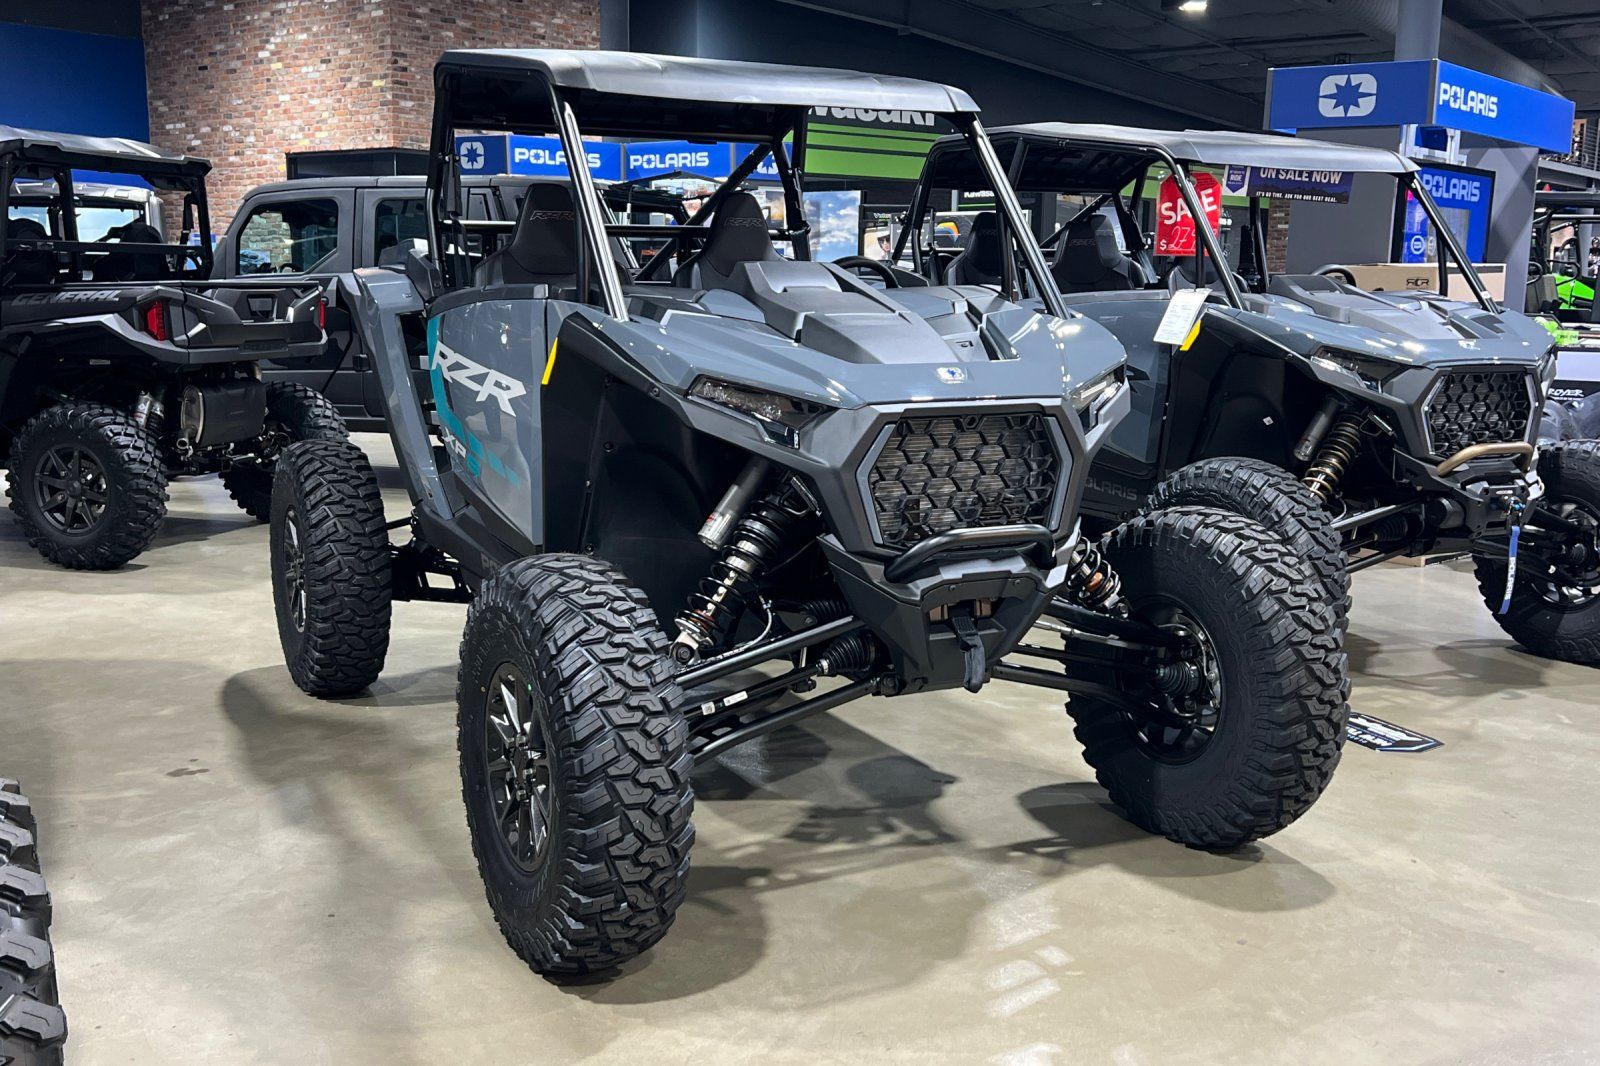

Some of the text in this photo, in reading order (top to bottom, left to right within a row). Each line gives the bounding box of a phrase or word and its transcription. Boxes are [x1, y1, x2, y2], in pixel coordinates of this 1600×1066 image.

[1439, 82, 1499, 118] POLARIS
[514, 147, 601, 168] POLAS
[629, 151, 710, 169] POLARIS
[1278, 169, 1310, 182] SALE
[1311, 171, 1342, 185] NOW
[1422, 173, 1481, 203] POLARIS
[1160, 188, 1218, 225] SAE
[10, 289, 122, 306] GENERAL
[431, 340, 527, 418] RZR
[441, 426, 467, 459] XP
[1503, 556, 1517, 602] POLARIS
